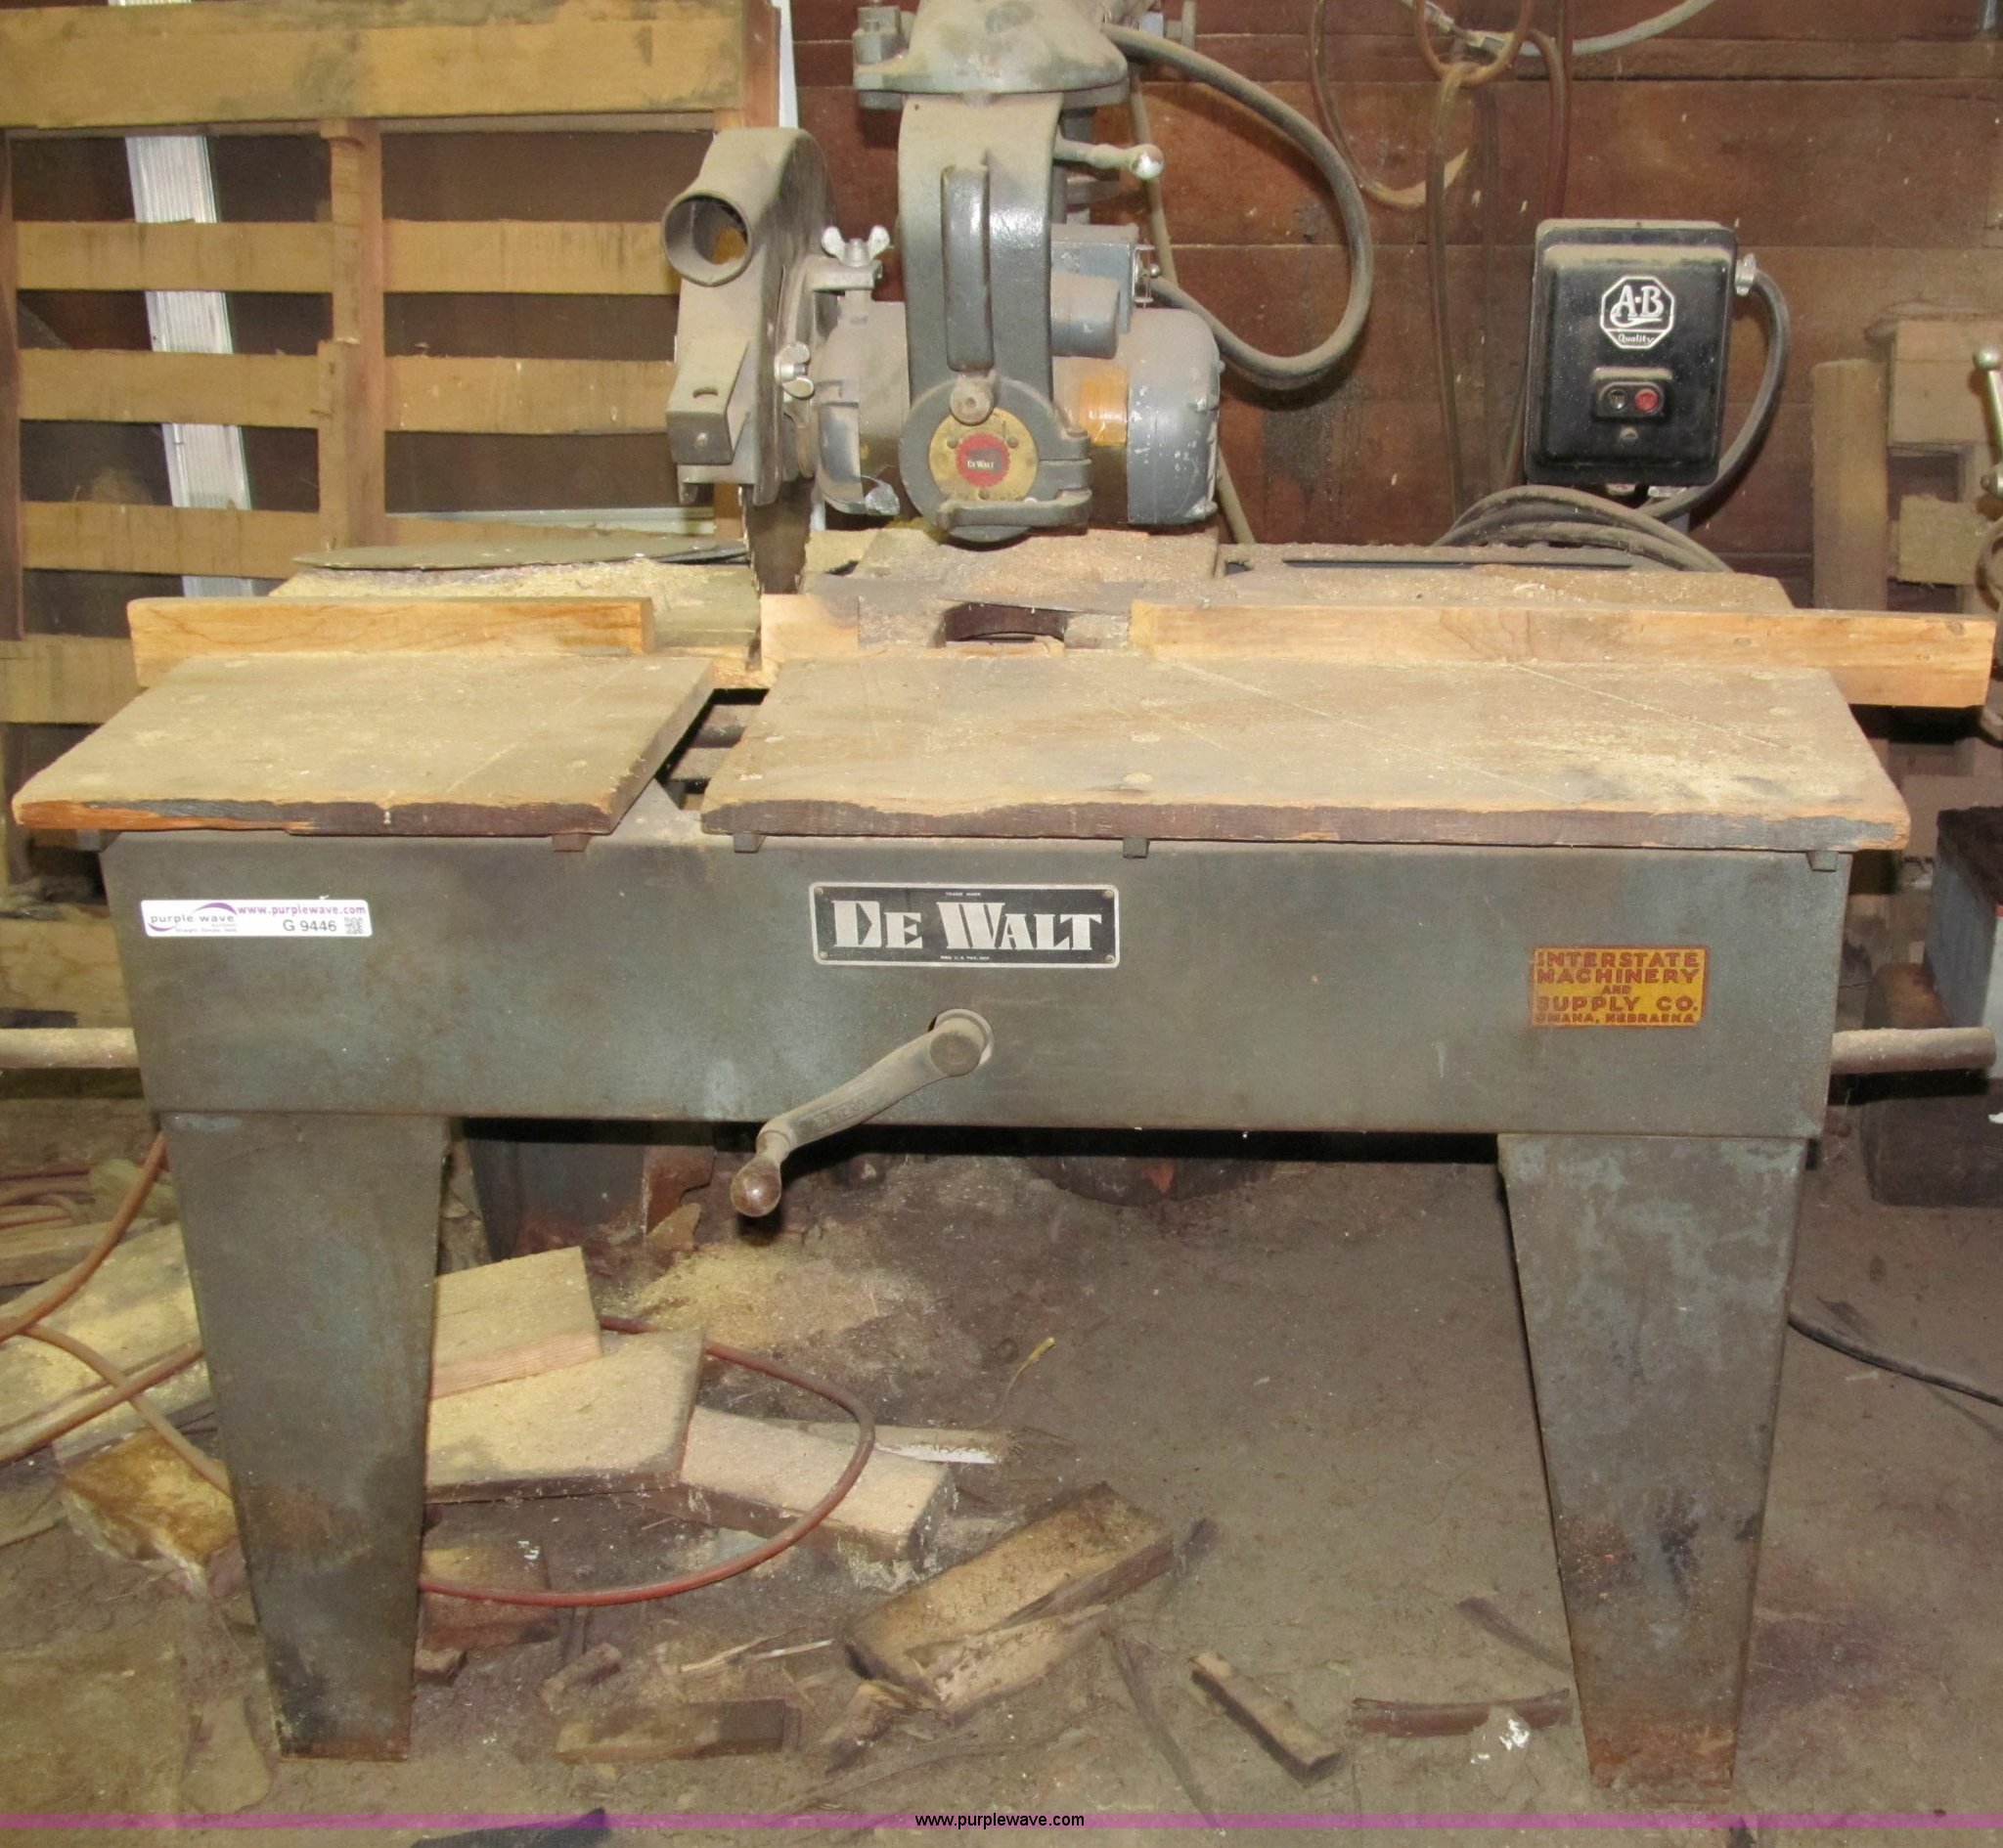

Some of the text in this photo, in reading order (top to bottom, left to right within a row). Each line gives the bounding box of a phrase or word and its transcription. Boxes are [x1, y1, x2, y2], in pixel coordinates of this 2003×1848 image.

[1618, 333, 1655, 344] Quality
[238, 904, 366, 917] www.purplewave.com
[151, 914, 194, 924] purple
[283, 919, 337, 932] G 9446
[936, 902, 1102, 950] WALT
[1536, 952, 1699, 967] INTERSTATE
[1536, 969, 1700, 984] MACHINERY
[1601, 986, 1632, 994] AND
[1536, 995, 1698, 1012] SUPPLY CO.
[1605, 1013, 1695, 1024] NEBRASKA
